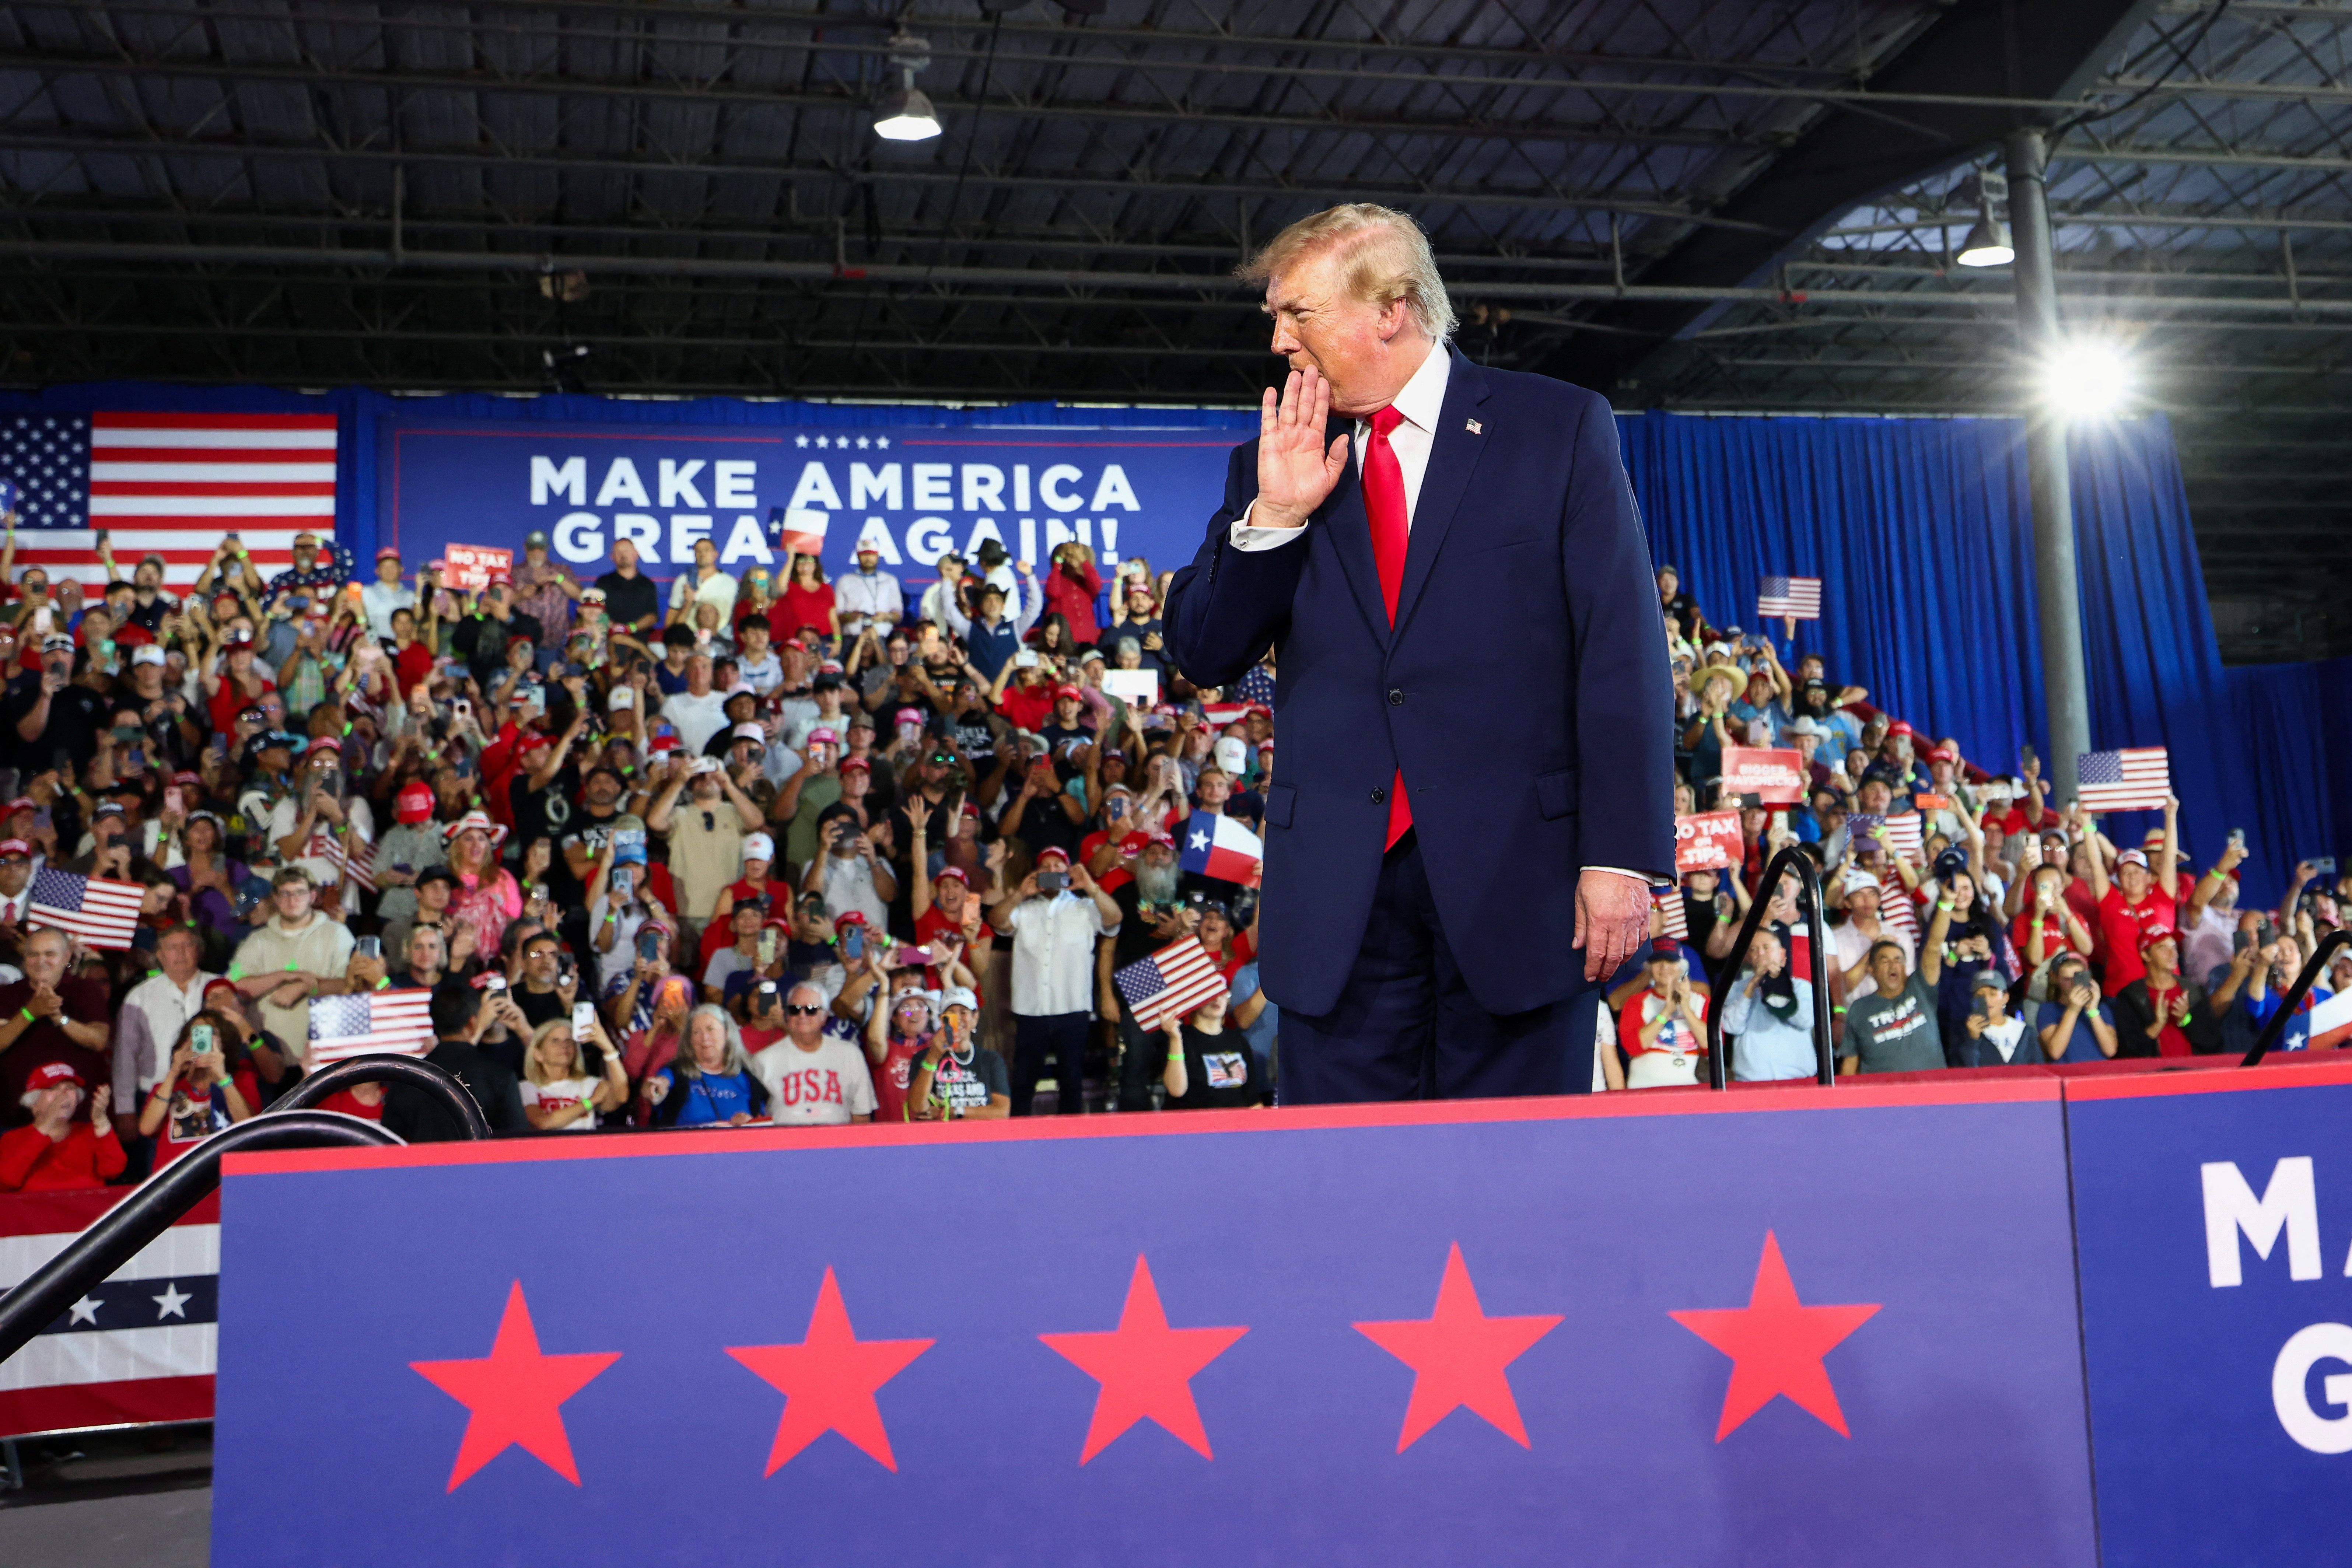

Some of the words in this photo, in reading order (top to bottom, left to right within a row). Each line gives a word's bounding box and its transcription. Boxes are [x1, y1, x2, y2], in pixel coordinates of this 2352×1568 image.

[530, 456, 757, 508] MAKE
[788, 461, 1141, 512] AMERICA
[552, 512, 775, 564] GREA
[850, 517, 1118, 566] AGAIN!
[450, 550, 475, 565] NO
[478, 553, 508, 568] TAX
[1739, 764, 1786, 775] BIGGER
[1726, 774, 1801, 787] PAYCHECKS
[1697, 818, 1736, 836] TAX
[1683, 844, 1727, 864] TIPS
[782, 1069, 843, 1107] USA
[2201, 1156, 2352, 1288] M
